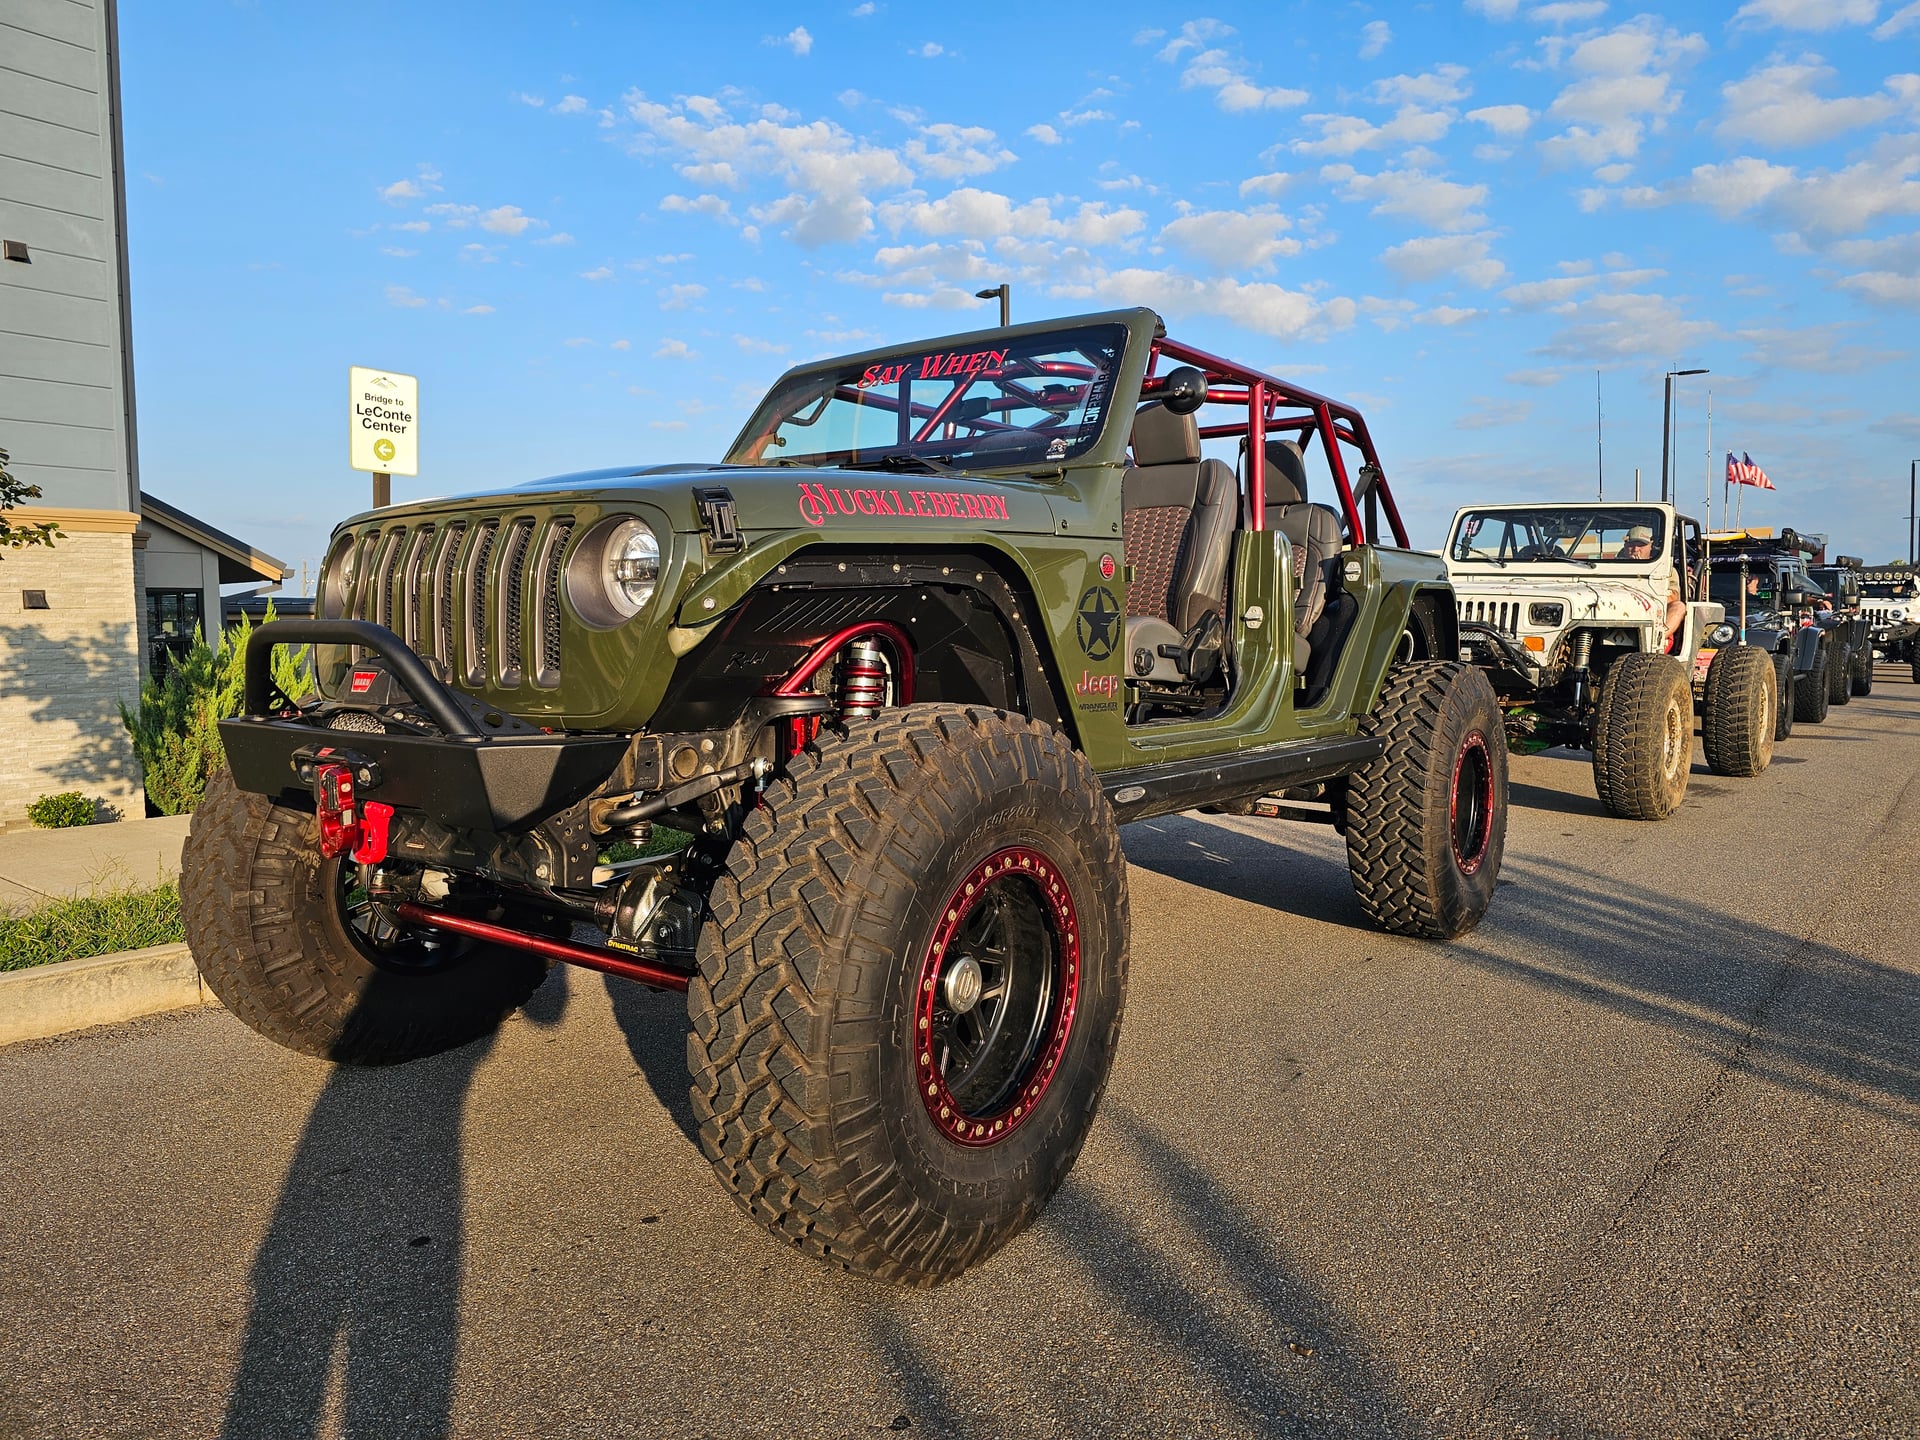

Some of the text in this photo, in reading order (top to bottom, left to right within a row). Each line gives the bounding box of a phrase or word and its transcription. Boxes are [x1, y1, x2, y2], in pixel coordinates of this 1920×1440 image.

[857, 348, 1009, 389] SAY WHEN
[365, 393, 404, 406] Bridge to
[356, 403, 412, 422] LeConte
[362, 417, 407, 434] Center
[798, 483, 1010, 527] HUCKLEBERRY
[1076, 670, 1118, 699] Jeep
[1078, 702, 1118, 710] WRANGLER
